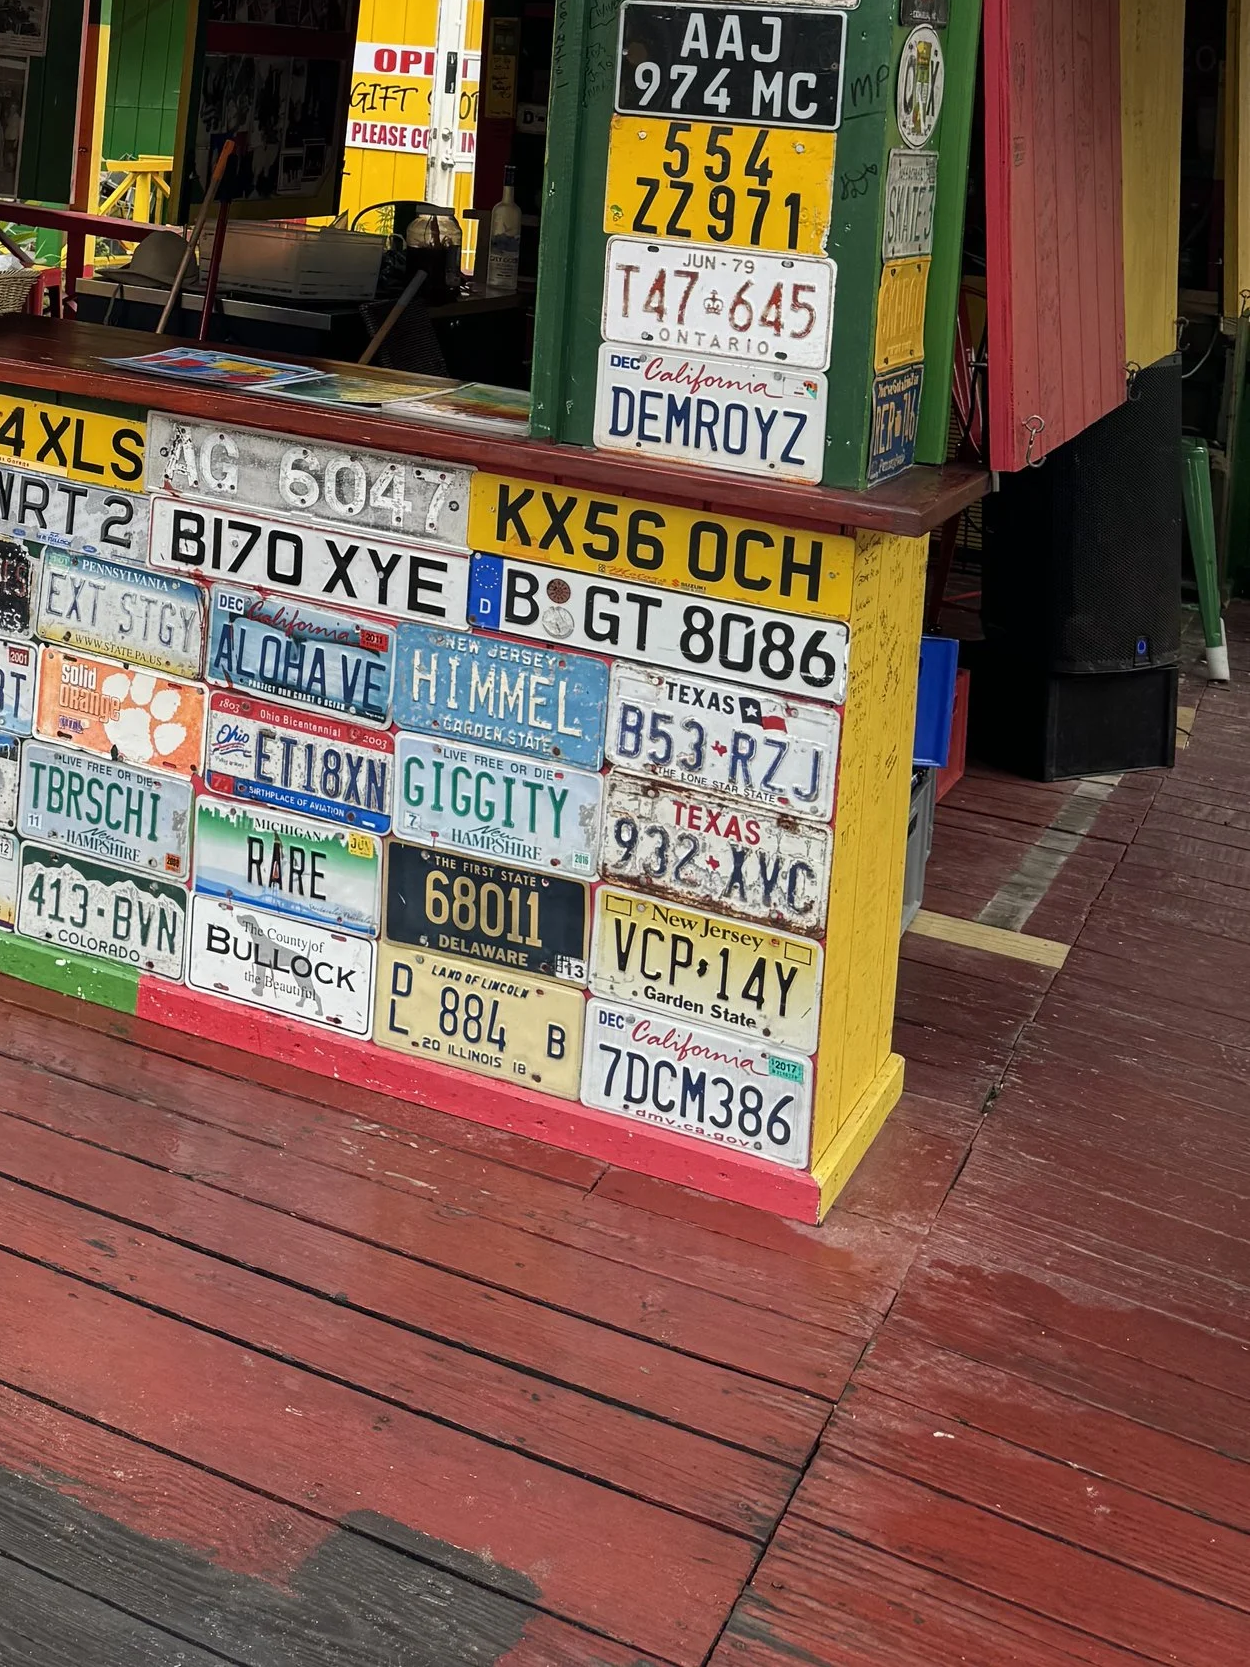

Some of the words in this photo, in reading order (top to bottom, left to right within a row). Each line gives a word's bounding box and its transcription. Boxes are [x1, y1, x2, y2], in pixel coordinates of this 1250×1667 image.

[679, 12, 783, 64] AAJ
[349, 81, 419, 114] GIFT
[634, 61, 731, 114] 974
[751, 69, 818, 120] MC
[351, 120, 407, 147] PLEASE
[659, 326, 770, 355] ONTARIO
[610, 353, 641, 371] DEC
[643, 356, 783, 399] California
[608, 384, 808, 466] DEMROYZ
[82, 560, 169, 593] PENNSYLVANIA
[444, 633, 481, 656] NEW
[488, 644, 558, 668] JERSEY
[247, 678, 275, 694] PROTECT
[278, 685, 292, 698] OUR
[294, 689, 316, 705] COAST
[324, 697, 345, 711] OCEAN
[411, 648, 584, 740] HIMMEL
[665, 681, 735, 715] TEXAS
[62, 754, 82, 768] LIVE
[87, 760, 112, 776] FREE
[117, 768, 132, 781] OR
[136, 774, 153, 788] DIE
[442, 747, 468, 763] LIVE
[473, 754, 504, 772] FREE
[510, 761, 528, 775] OR
[534, 767, 554, 782] DIE
[403, 755, 570, 840] GIGGITY
[657, 766, 677, 779] THE
[680, 771, 707, 785] LONE
[712, 779, 739, 794] STAR
[743, 787, 776, 804] STATE
[253, 817, 322, 843] MICHIGAN
[672, 800, 762, 846] TEXAS
[246, 834, 328, 901] RARE
[434, 855, 457, 871] THE
[463, 862, 494, 879] FIRST
[500, 870, 537, 888] STATE
[424, 869, 543, 949] 68011
[58, 928, 140, 963] COLORADO
[242, 919, 264, 937] The
[267, 927, 309, 952] County
[311, 940, 325, 954] of
[650, 904, 700, 933] New
[700, 918, 764, 953] Jersey
[205, 922, 358, 994] BULLOCK
[438, 933, 529, 967] DELAWARE
[243, 969, 261, 985] the
[264, 976, 317, 1002] Beautiful
[431, 964, 461, 981] LAND
[465, 972, 479, 984] OF
[480, 975, 530, 999] LINCOLN
[643, 985, 705, 1016] Garden
[710, 1004, 757, 1030] State
[598, 1042, 795, 1147] 7DCM386
